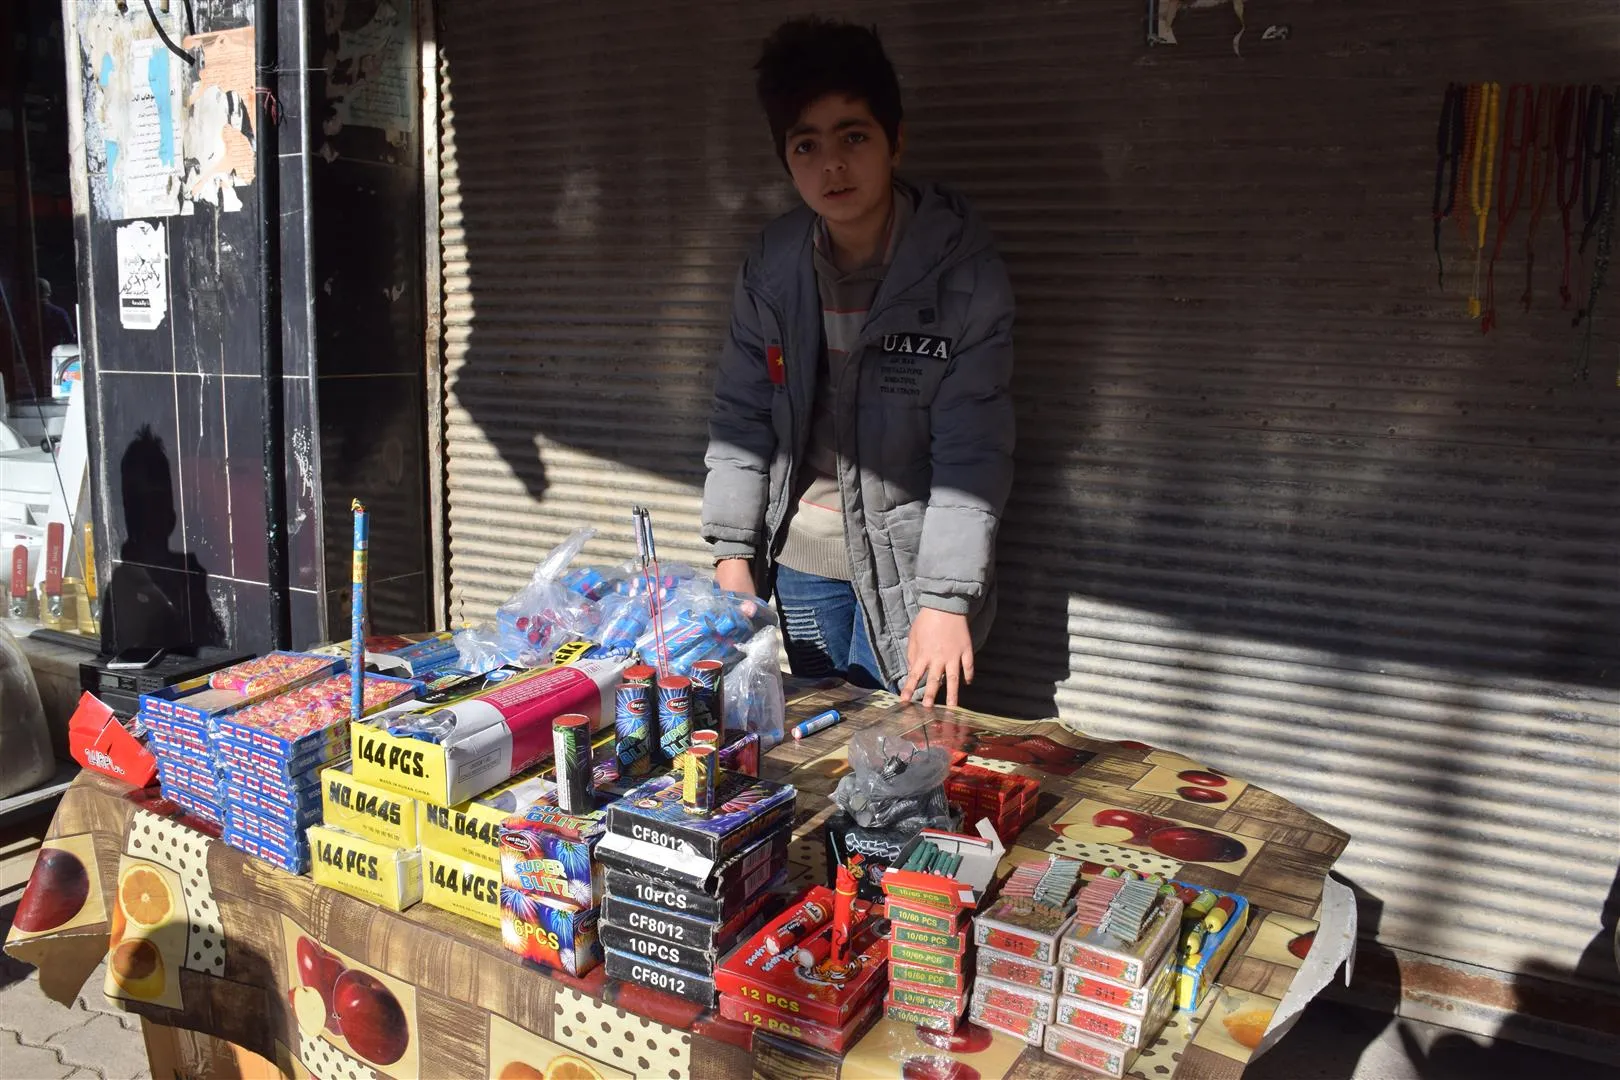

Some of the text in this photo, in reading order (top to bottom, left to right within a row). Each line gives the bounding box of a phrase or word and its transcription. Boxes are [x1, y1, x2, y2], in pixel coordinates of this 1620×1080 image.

[883, 334, 948, 359] UAZA
[358, 735, 387, 768] 144
[389, 745, 429, 778] PCS.
[329, 780, 401, 825] NO.0445
[427, 803, 500, 848] NO.0445
[632, 824, 685, 852] CF8012
[317, 839, 383, 882] 144 PCS.
[515, 858, 568, 879] SUPER
[429, 860, 458, 894] 144
[519, 875, 576, 899] BLITZ
[635, 884, 687, 909] 10PCS
[629, 912, 684, 940] CF8012
[899, 911, 937, 927] 10/60 PCS
[514, 919, 560, 950] 6PCS
[906, 932, 947, 945] 10/60 PCS
[630, 938, 680, 963] 10PCS
[632, 965, 685, 994] CF8012
[741, 986, 800, 1012] 12 PCS
[743, 1011, 801, 1038] 12 PCS
